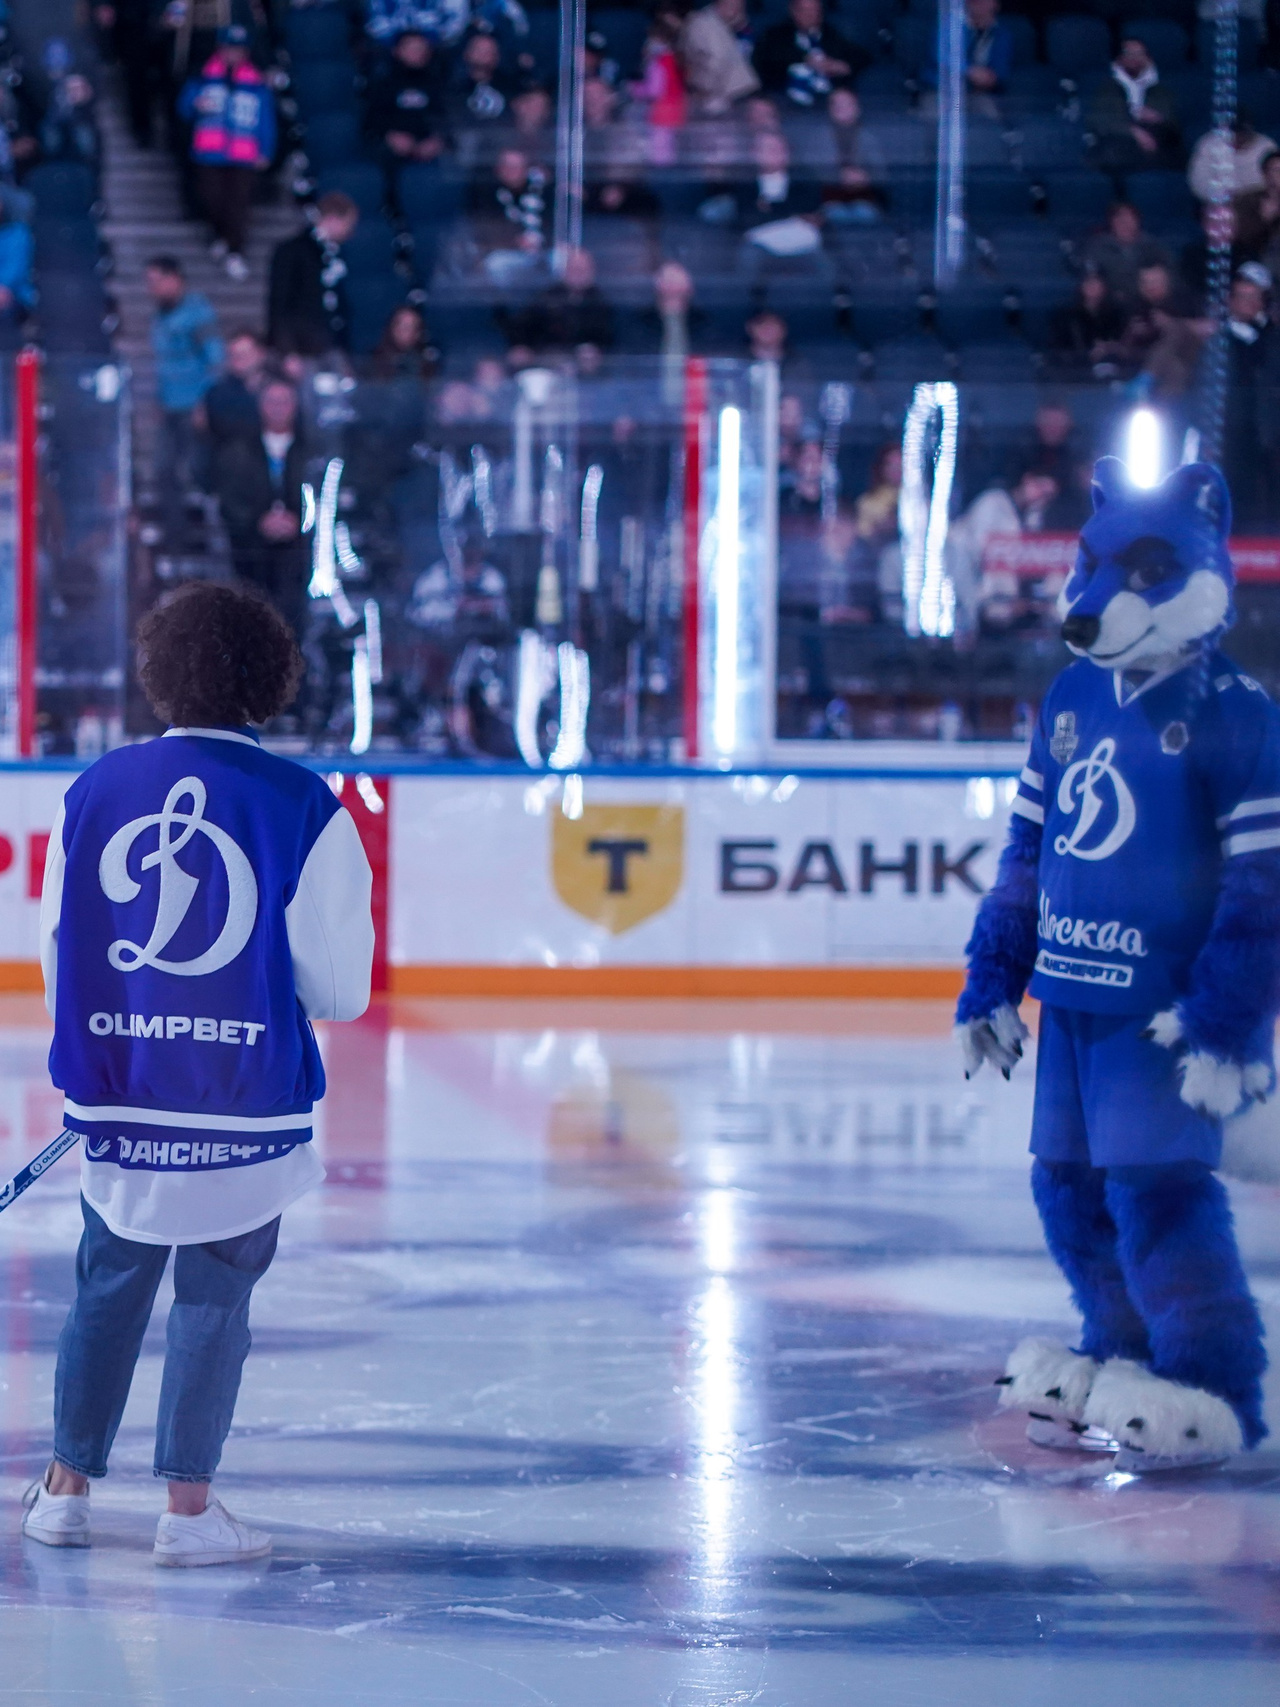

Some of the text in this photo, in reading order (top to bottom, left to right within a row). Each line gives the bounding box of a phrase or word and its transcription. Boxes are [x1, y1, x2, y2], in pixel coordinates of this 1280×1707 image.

[720, 839, 988, 893] БАНК
[88, 1012, 266, 1046] OLIMPBET
[41, 1132, 76, 1164] OLIMPBET
